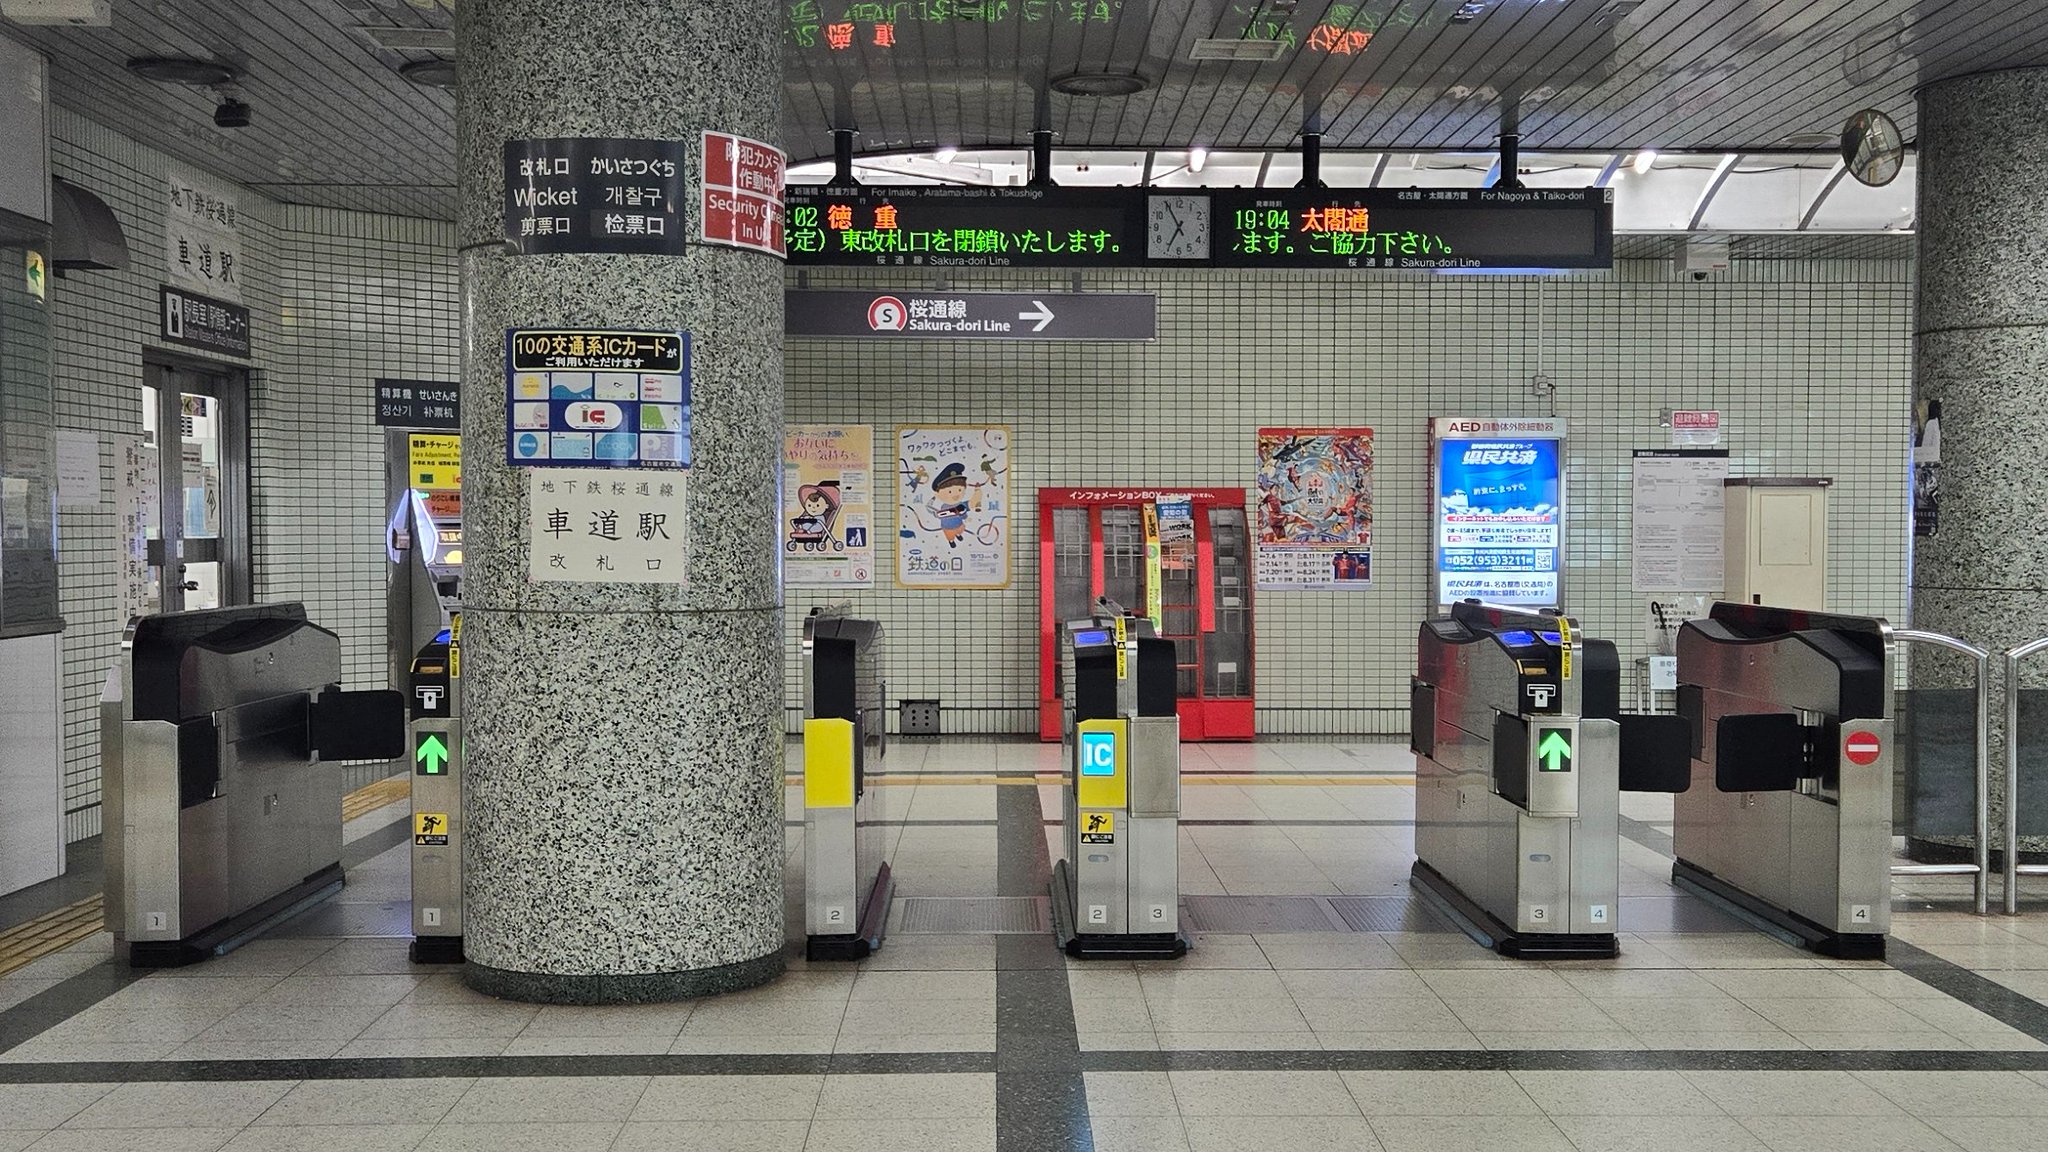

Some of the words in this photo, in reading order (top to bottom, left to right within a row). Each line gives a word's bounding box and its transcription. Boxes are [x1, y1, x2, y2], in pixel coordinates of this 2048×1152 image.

[520, 157, 570, 177] 改札口
[590, 156, 676, 178] かいさつぐち
[514, 187, 578, 207] Wicket
[605, 186, 663, 207] 개찰구
[999, 188, 1044, 200] Tokushige
[1481, 191, 1496, 200] For
[1498, 191, 1531, 202] Nagoya
[1533, 191, 1539, 200] &
[1541, 191, 1585, 200] Taiko-dori
[708, 194, 759, 220] Security
[827, 204, 898, 230] 徳重
[1235, 209, 1290, 230] 19:04
[1300, 207, 1369, 233] 太閤通
[520, 216, 571, 236] 剪票口
[604, 214, 665, 236] 检票口
[178, 235, 236, 283] 車道駅
[876, 255, 923, 265] 桜通線
[930, 255, 987, 266] Sakura-dori
[989, 255, 1010, 266] Line
[1348, 257, 1394, 267] 桜通線
[1400, 257, 1457, 267] Sakura-dori
[1459, 257, 1481, 267] Line
[909, 299, 967, 318] 桜通線
[909, 319, 981, 332] Sakura-dori
[983, 319, 1011, 332] Line
[544, 357, 645, 368] ご利用いただけます
[381, 387, 412, 400] 精算機
[418, 388, 458, 402] せいさんき
[381, 404, 412, 418] 정산기
[1448, 422, 1482, 432] AED
[1461, 450, 1538, 465] 県民共済
[540, 480, 674, 497] 地下鉄桜通線
[543, 507, 671, 541] 車道駅
[549, 553, 662, 572] 改札口
[1085, 742, 1112, 767] IC
[429, 912, 435, 922] 1
[830, 910, 840, 920] 2
[1092, 909, 1102, 919] 2
[1153, 908, 1163, 918] 3
[1534, 908, 1544, 918] 3
[1593, 908, 1604, 918] 4
[1856, 908, 1866, 919] 4
